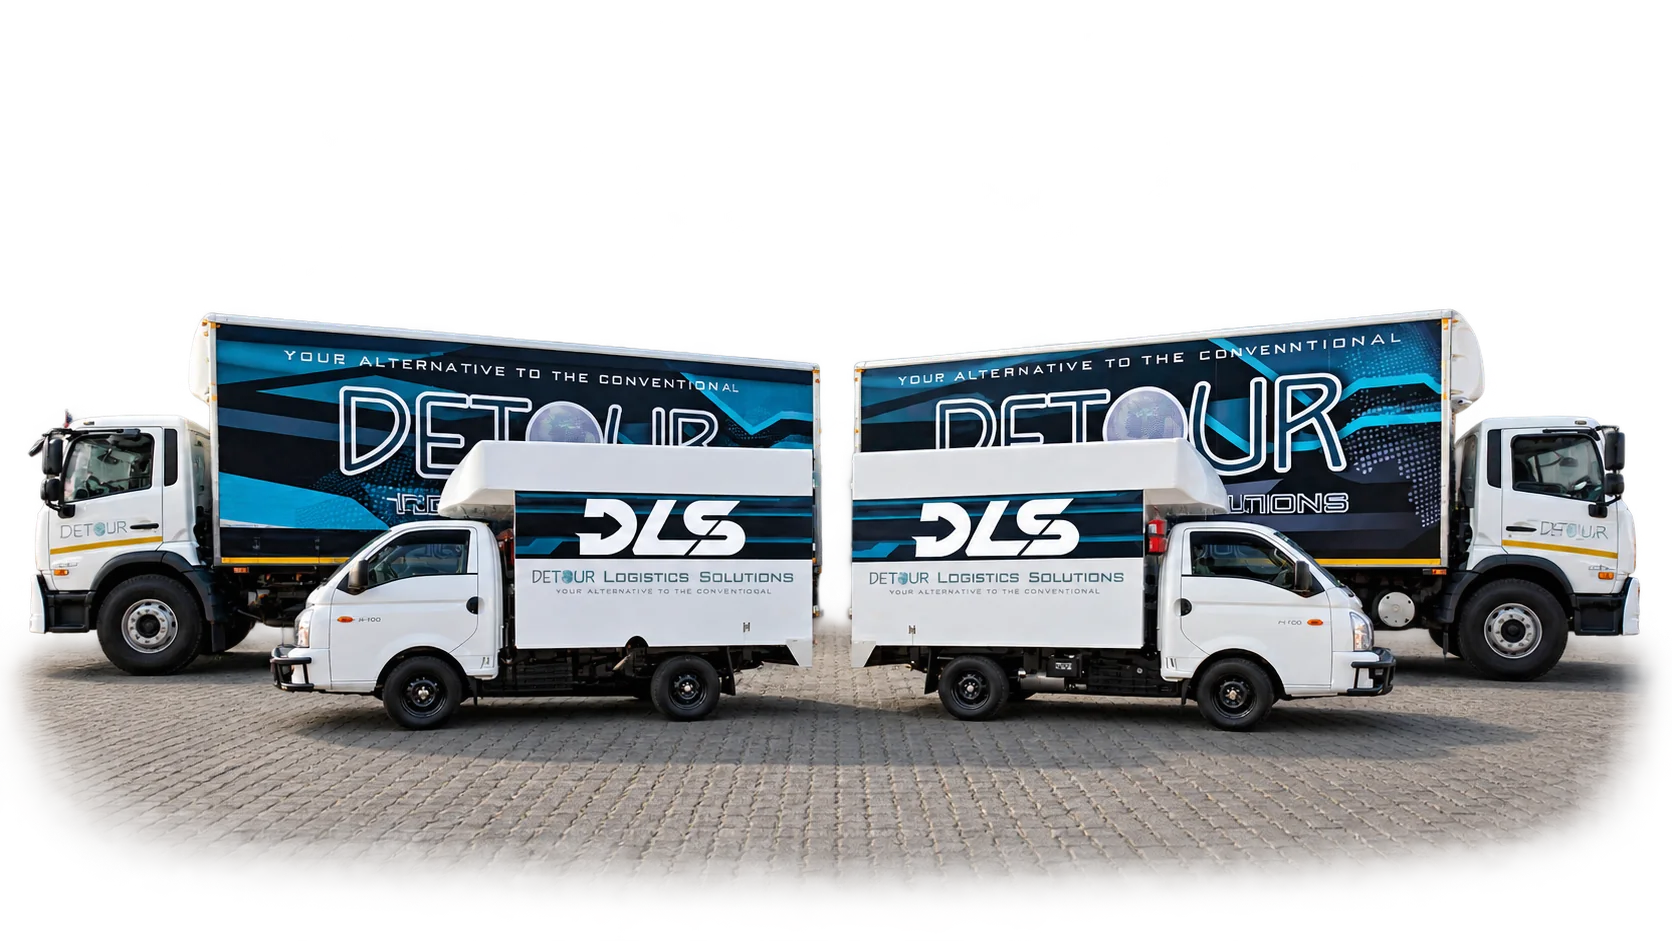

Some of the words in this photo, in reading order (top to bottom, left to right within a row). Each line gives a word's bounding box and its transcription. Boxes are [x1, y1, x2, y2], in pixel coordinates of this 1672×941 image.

[284, 350, 346, 365] YOUR
[359, 356, 506, 377] ALTERNATIVE
[516, 367, 541, 379] TO
[552, 371, 589, 383] THE
[599, 374, 740, 393] CONVENTIONAL
[898, 373, 945, 386] YOUR
[954, 360, 1092, 382] ALTERNATIVE
[1105, 357, 1131, 368] TO
[1141, 352, 1185, 365] THE
[1200, 333, 1402, 361] CONVENNTIONAL
[59, 520, 128, 539] DETOUR
[575, 498, 746, 556] DLS
[911, 498, 1080, 557] DLS
[532, 569, 595, 584] DETOUR
[869, 571, 929, 585] DETOUR
[918, 588, 982, 596] ALTERNATIVE
